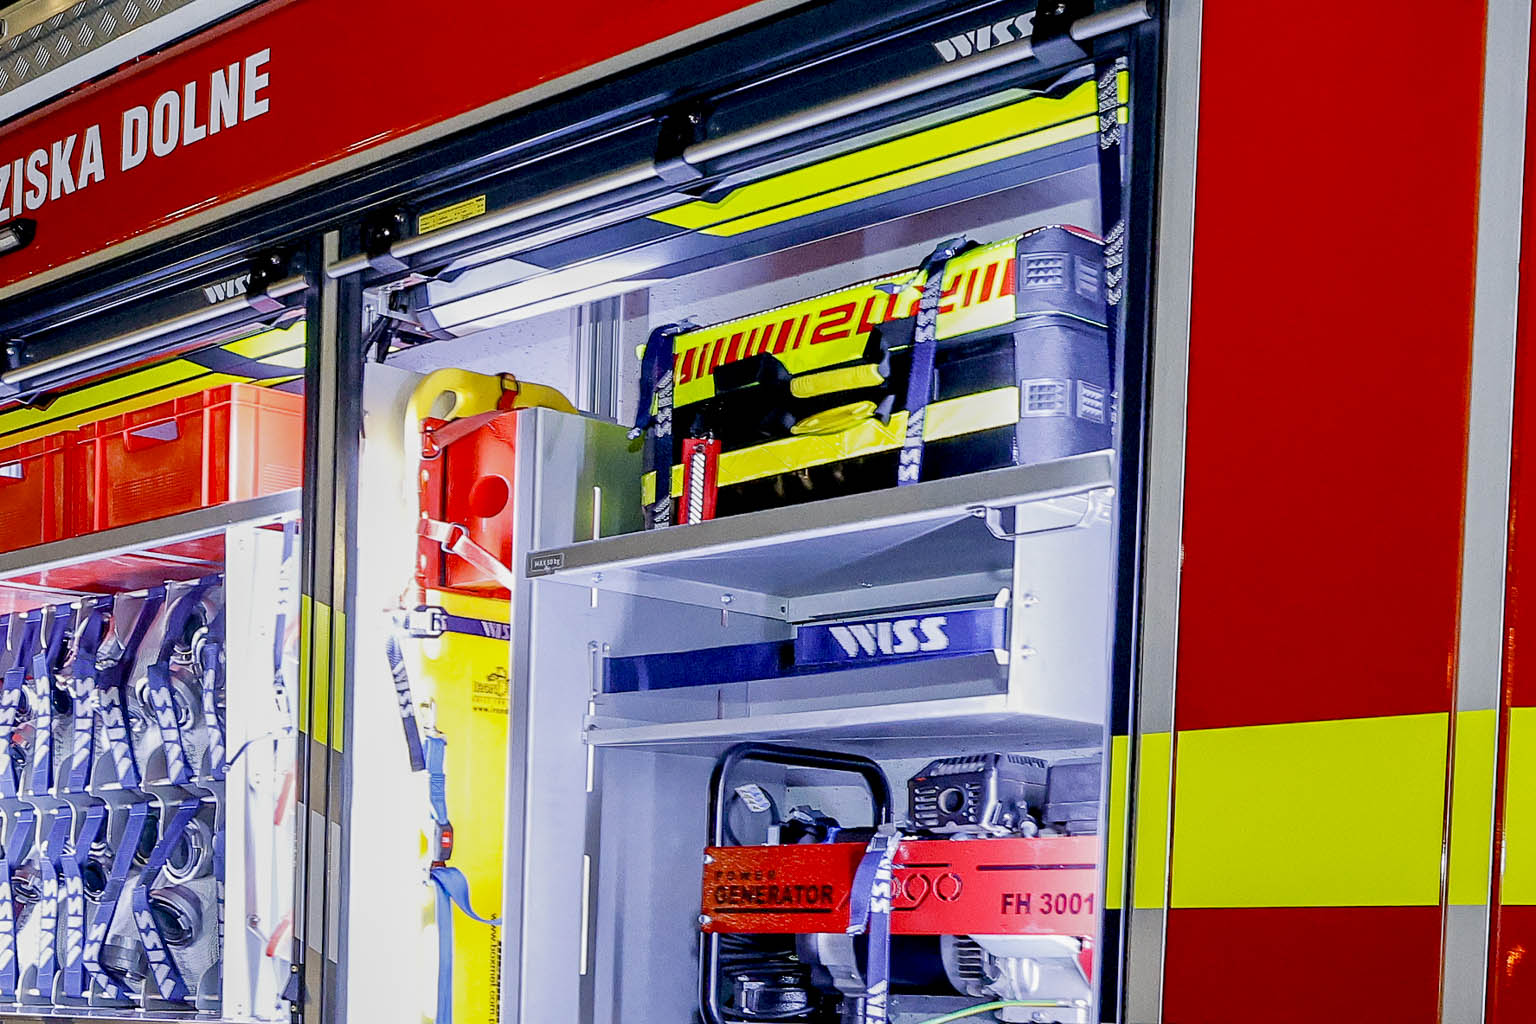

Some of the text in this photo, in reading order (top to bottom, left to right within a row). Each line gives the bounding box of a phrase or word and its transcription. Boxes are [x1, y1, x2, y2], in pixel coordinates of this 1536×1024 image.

[121, 47, 272, 172] DOLNE
[204, 273, 252, 304] WIS
[828, 616, 950, 658] WISS
[714, 884, 834, 905] GENERATOR
[1001, 892, 1095, 914] FH 3001
